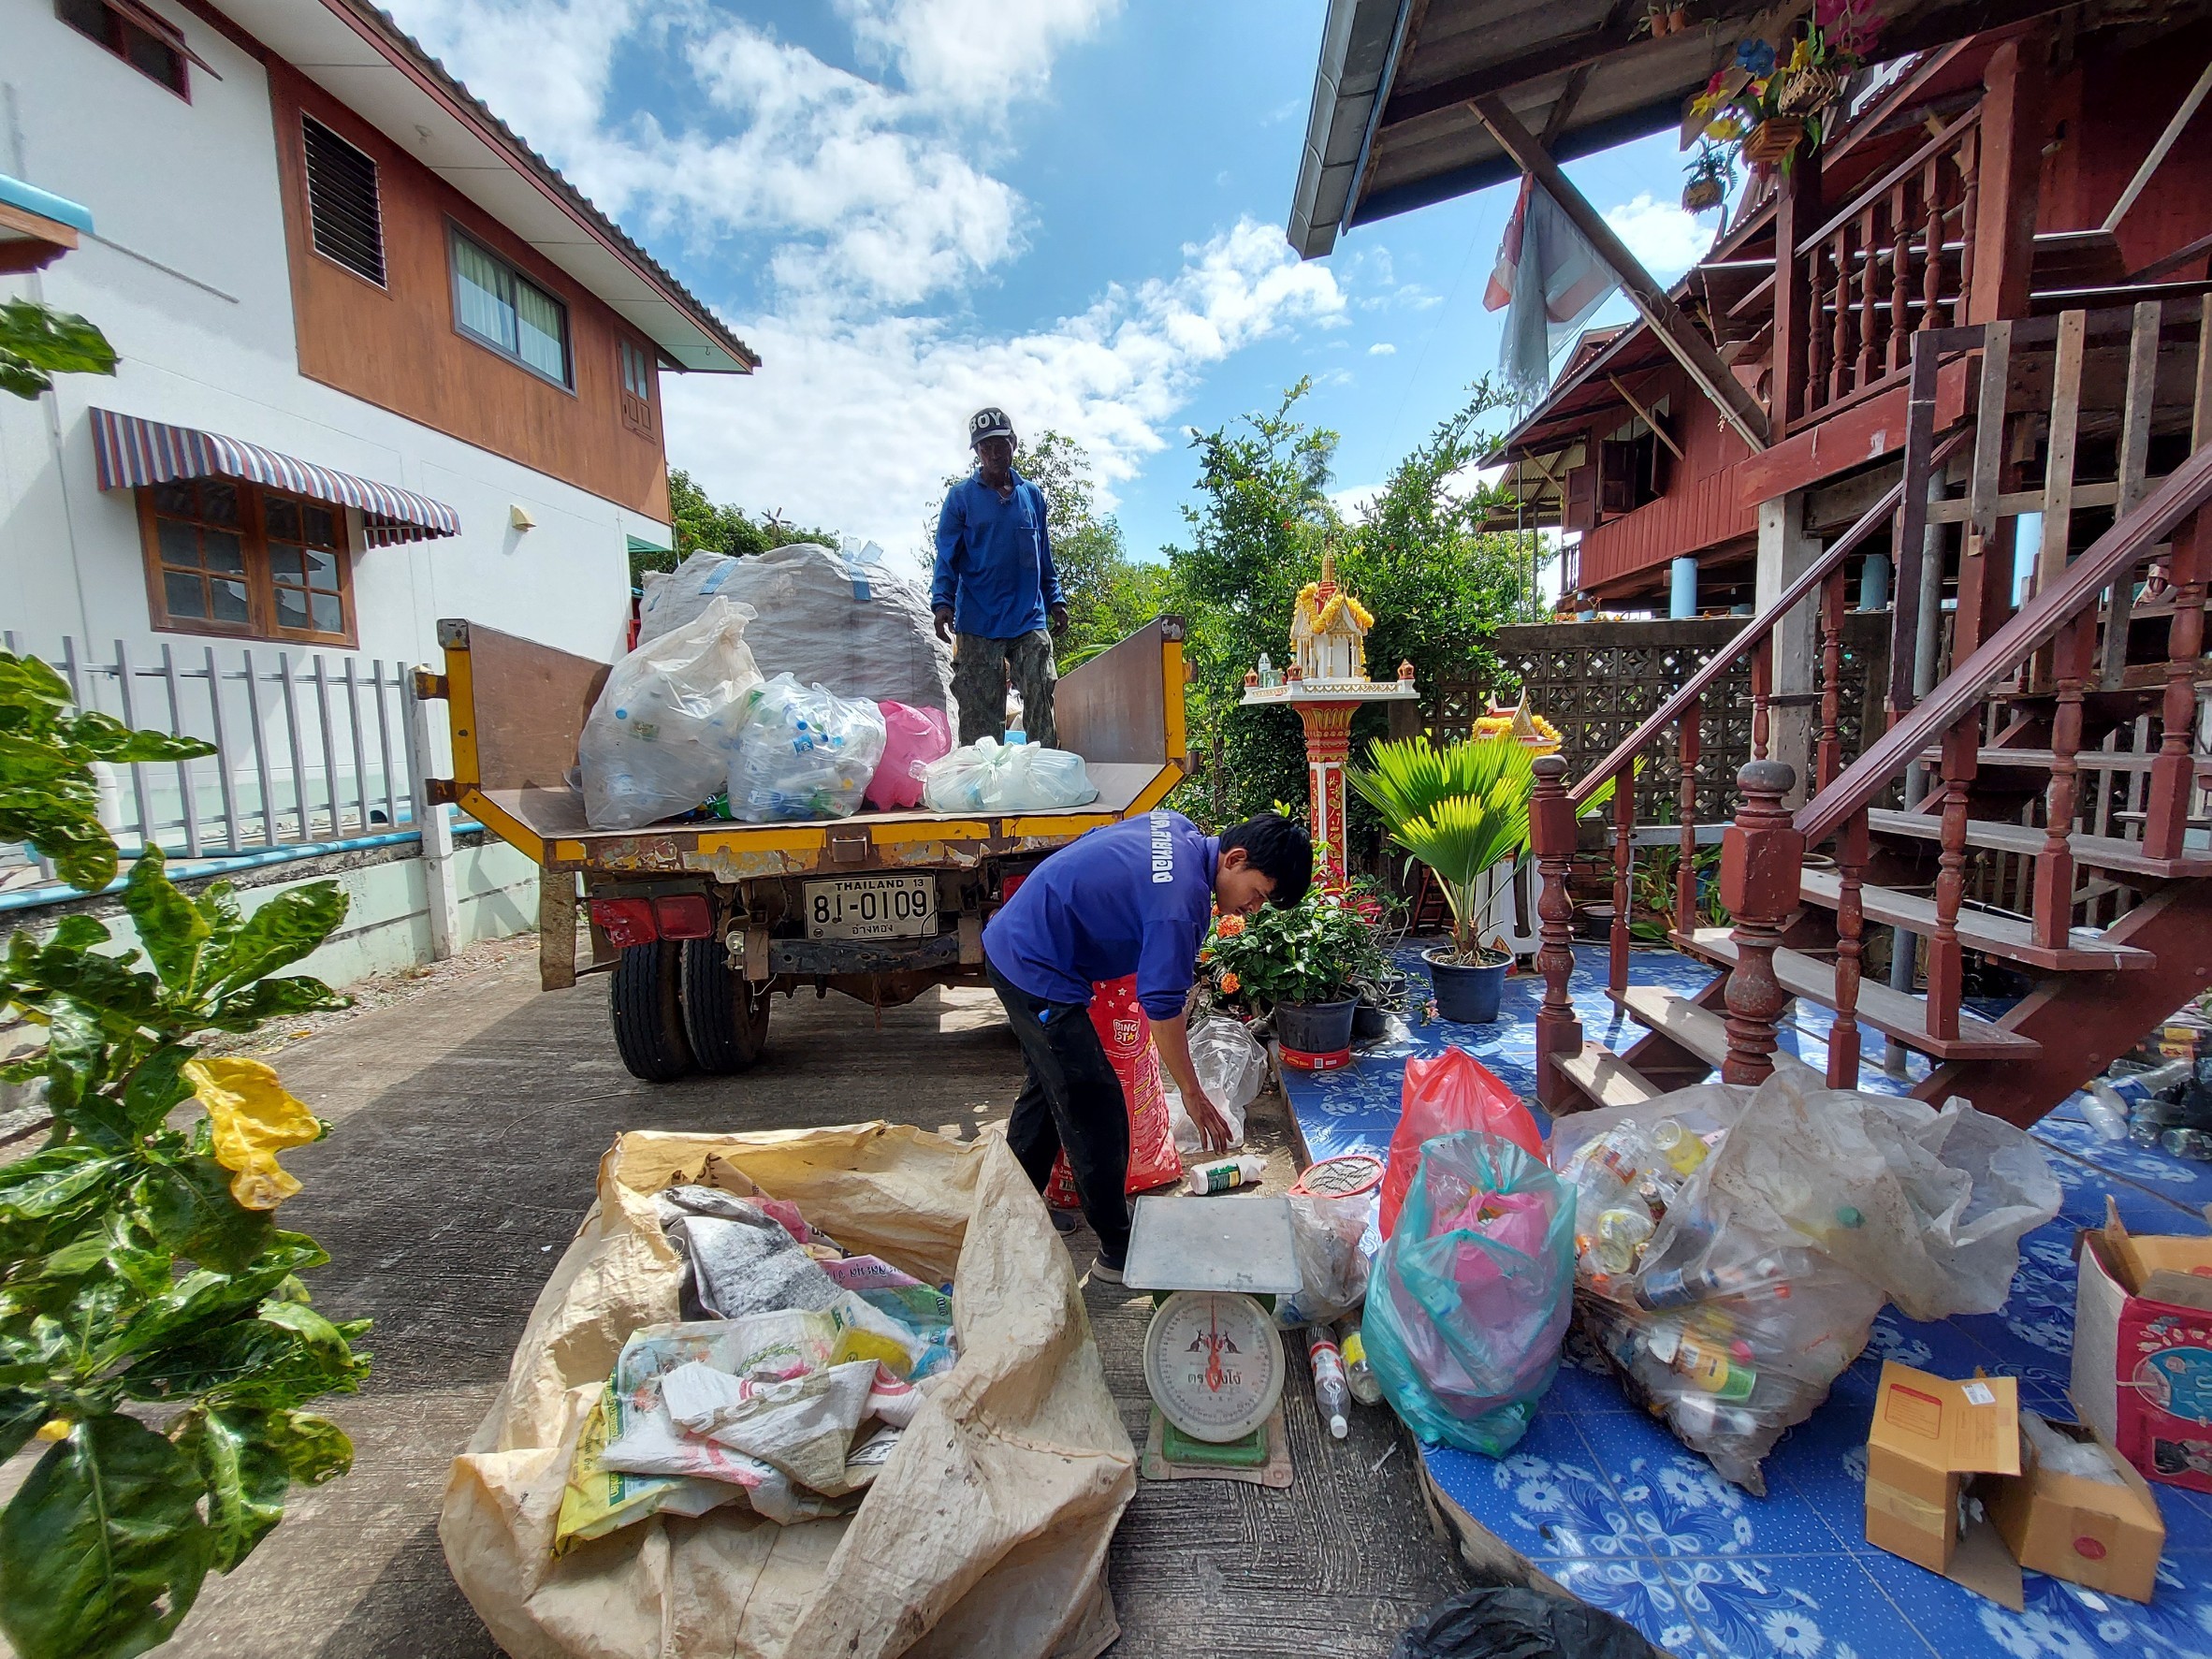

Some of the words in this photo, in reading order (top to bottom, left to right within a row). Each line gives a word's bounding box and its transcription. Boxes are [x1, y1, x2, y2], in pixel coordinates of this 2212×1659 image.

[969, 412, 1001, 434] BOY
[835, 880, 905, 892] THAILAND
[913, 879, 924, 888] 13
[813, 890, 927, 924] 81-0109
[851, 924, 894, 935] อ่างทอง
